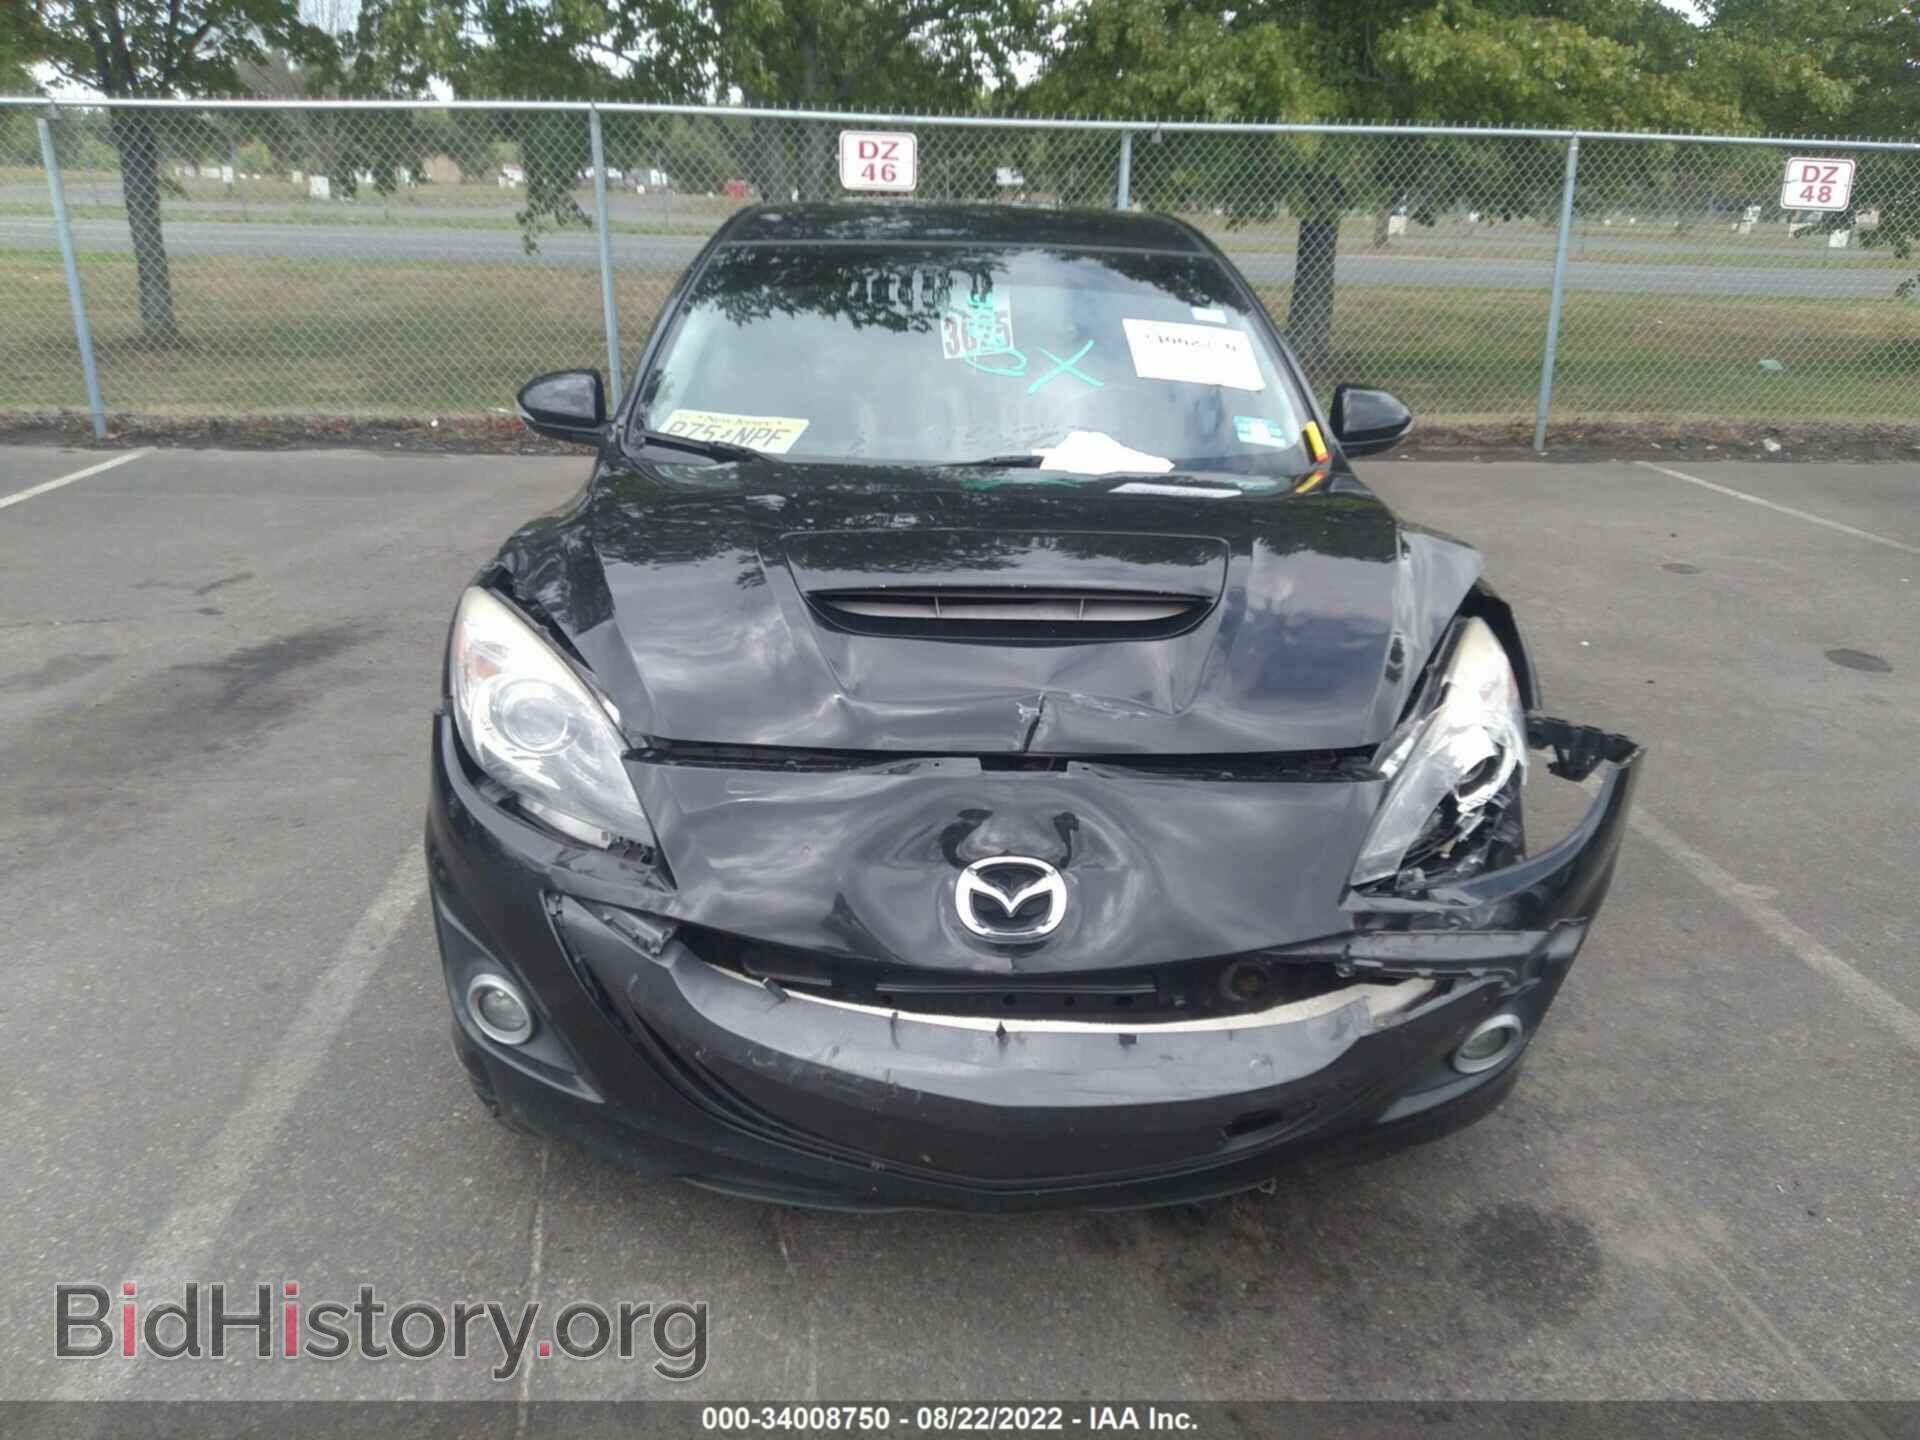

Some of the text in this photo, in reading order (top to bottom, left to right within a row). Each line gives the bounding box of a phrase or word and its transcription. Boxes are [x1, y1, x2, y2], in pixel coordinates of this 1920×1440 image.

[859, 140, 899, 161] DZ
[861, 162, 897, 183] 46
[1801, 165, 1839, 185] DZ
[1799, 185, 1832, 204] 48
